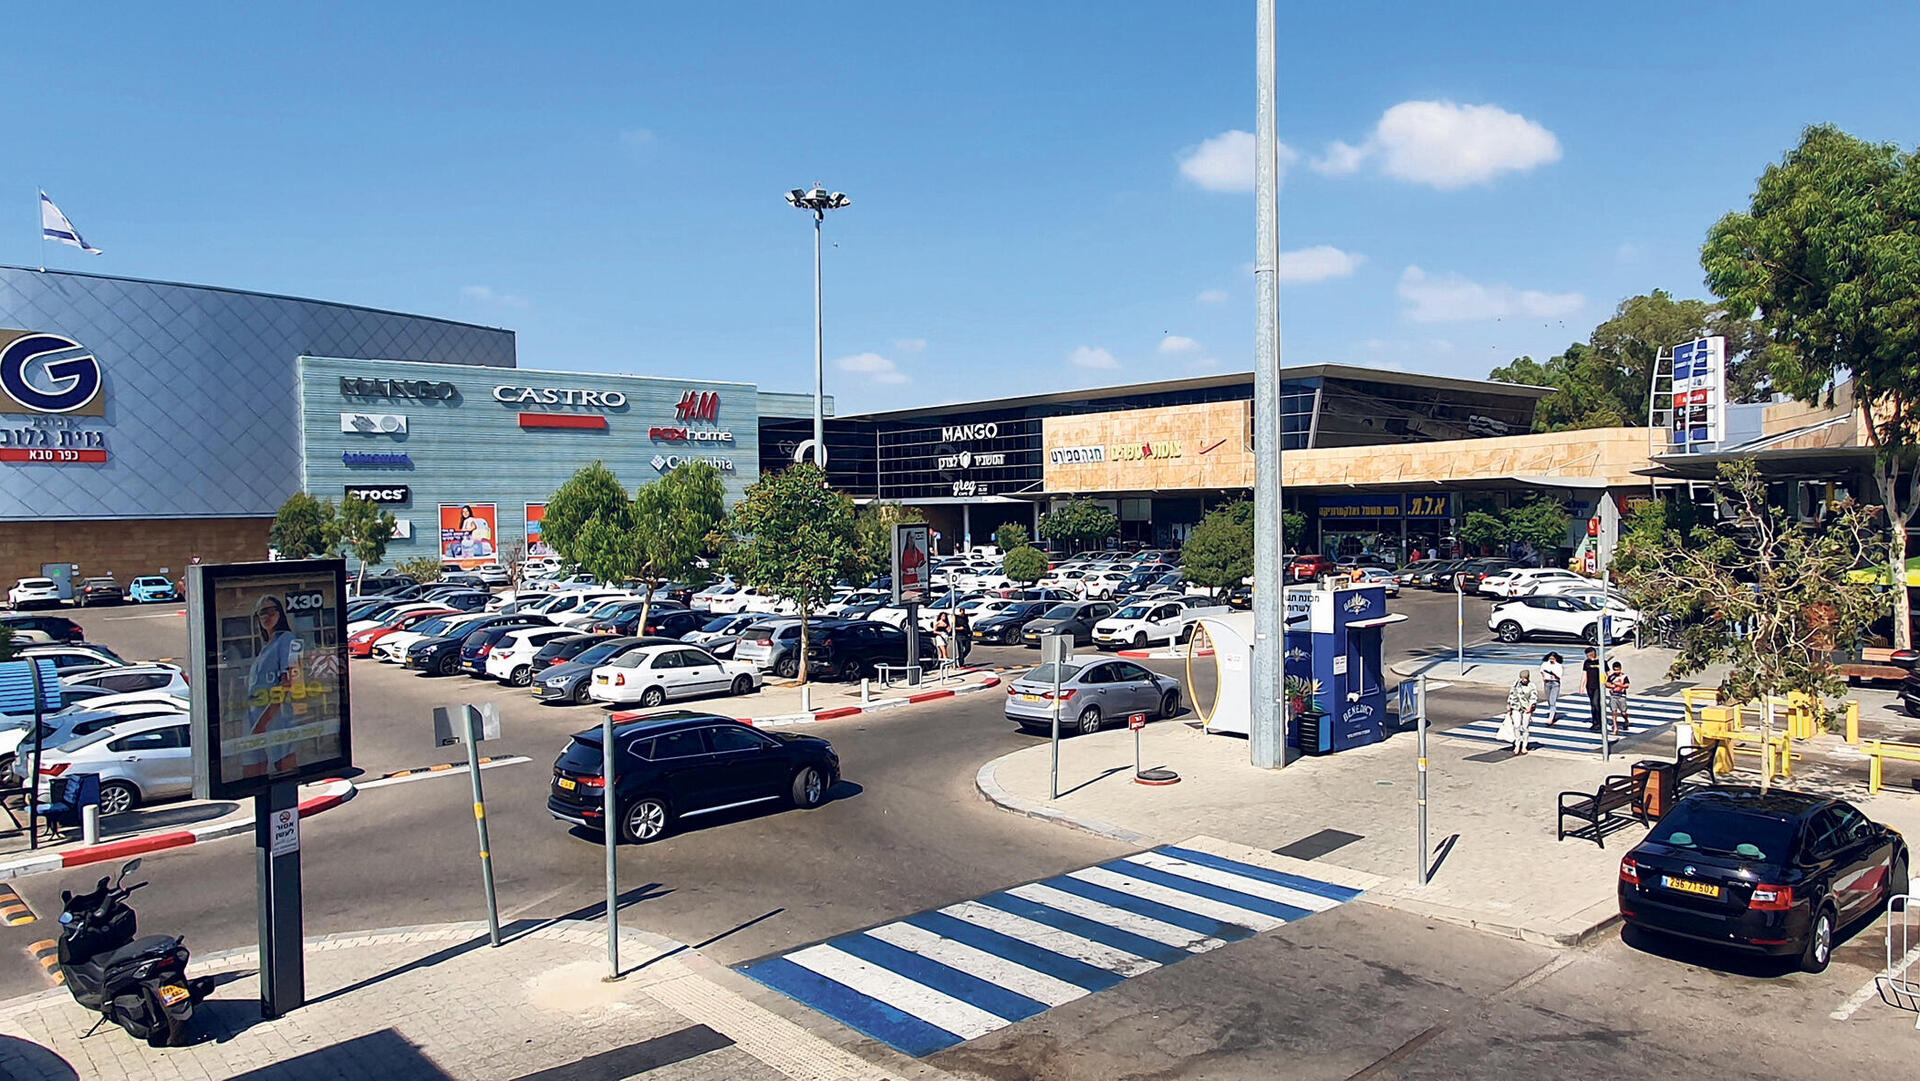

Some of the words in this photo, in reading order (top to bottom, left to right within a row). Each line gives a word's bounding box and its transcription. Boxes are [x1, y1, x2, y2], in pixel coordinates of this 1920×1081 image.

[493, 386, 626, 407] CASTRO
[674, 390, 718, 421] H&M
[59, 430, 104, 447] גזית
[942, 423, 997, 442] MANGO
[29, 450, 53, 460] סבא
[58, 450, 79, 460] כפר
[667, 455, 733, 469] Colmbia
[953, 480, 976, 496] greg
[276, 822, 294, 831] אסור
[275, 829, 295, 840] לעשן
